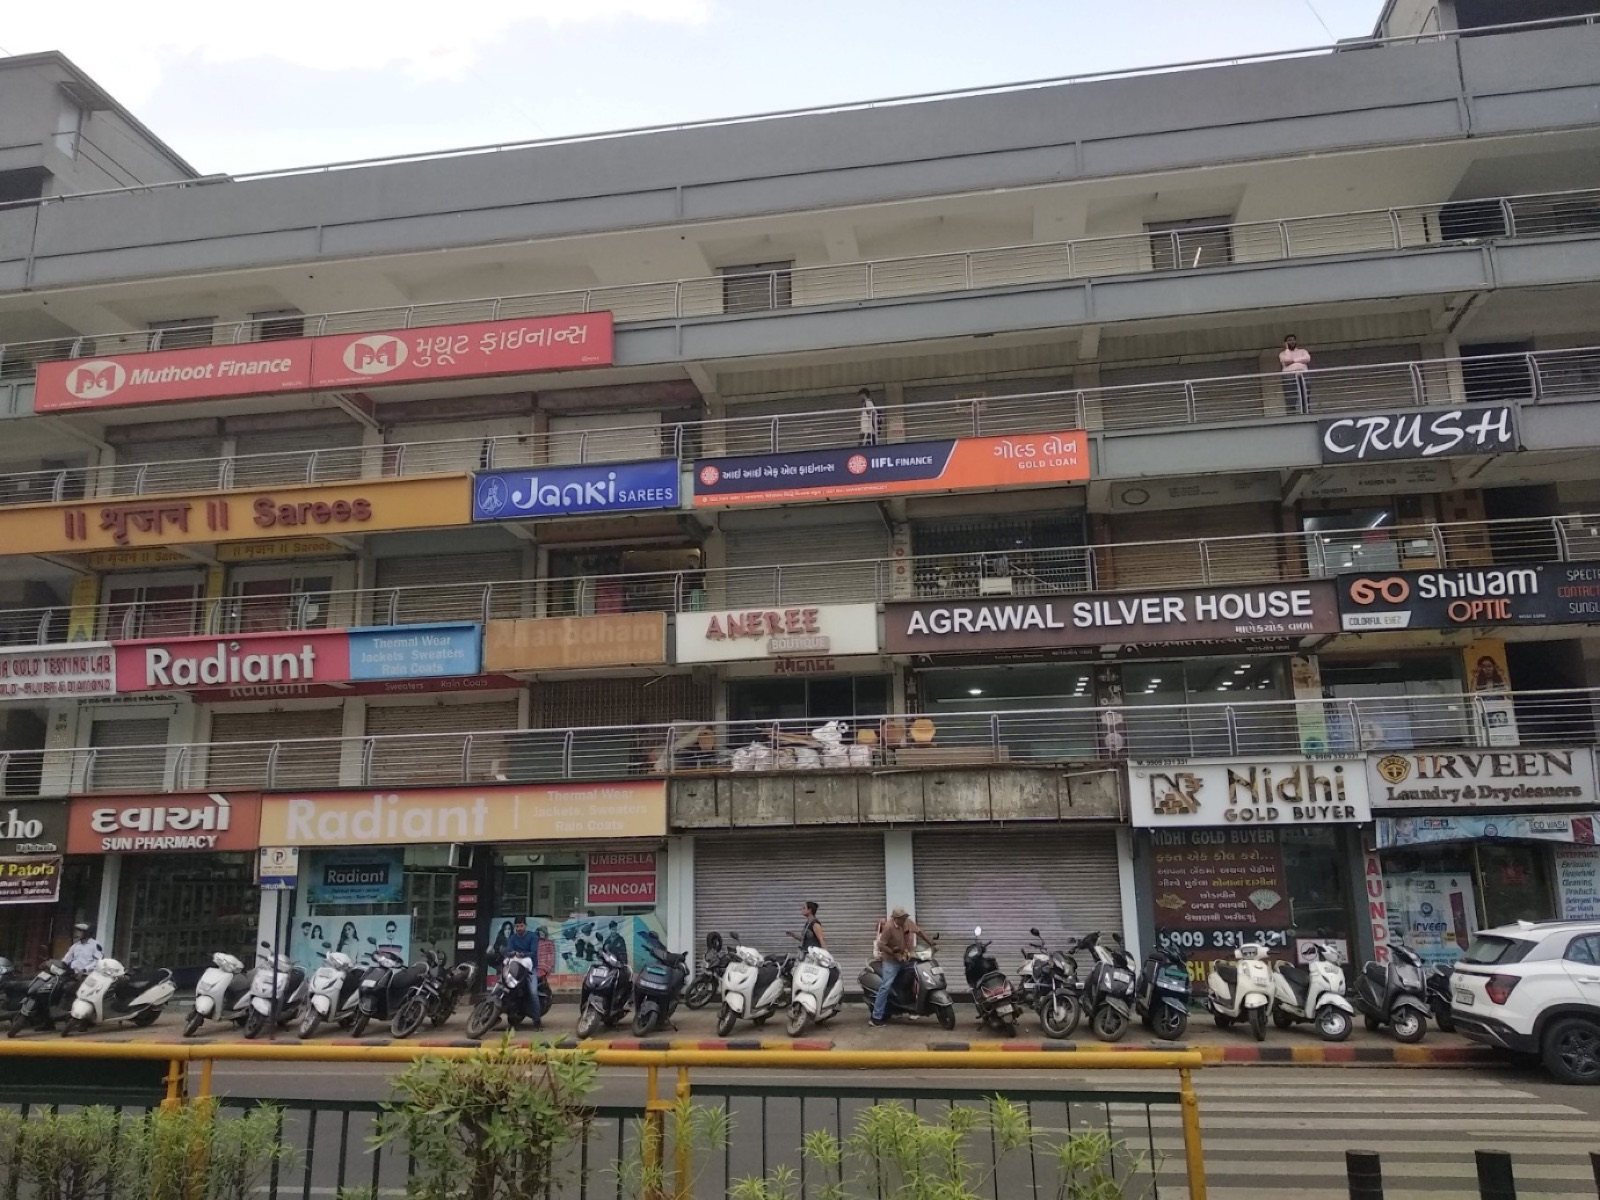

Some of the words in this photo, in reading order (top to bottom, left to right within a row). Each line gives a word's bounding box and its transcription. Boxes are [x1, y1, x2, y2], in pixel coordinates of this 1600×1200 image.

[413, 335, 469, 367] મુથૂટ
[129, 363, 213, 385] Muthoot
[216, 357, 292, 378] Finance
[1323, 408, 1511, 458] CRUSH
[994, 440, 1036, 459] ગોલ્ડ
[1043, 436, 1078, 456] લોન
[871, 457, 894, 469] IIFL
[895, 455, 933, 467] FINANCE
[1018, 460, 1046, 469] GOLD
[1049, 457, 1077, 467] LOAN
[511, 471, 617, 509] Janki
[619, 487, 674, 503] SAREES
[253, 497, 372, 527] Sarees
[294, 539, 332, 553] Sarees
[1417, 568, 1539, 599] Shivam
[907, 603, 1065, 635] AGRAWAL
[1073, 596, 1187, 628] SILVER
[1194, 589, 1314, 621] HOUSE
[1447, 598, 1512, 622] OPTIC
[705, 608, 821, 640] ANEREE
[1348, 616, 1382, 626] COLORFUL
[373, 636, 418, 649] Thermal
[421, 635, 452, 647] Wear
[771, 638, 825, 650] BOUTIQUE
[91, 654, 112, 673] LAB
[145, 642, 316, 687] Radiant
[360, 652, 405, 664] Jackets
[411, 648, 465, 661] Sweaters
[382, 664, 408, 675] Rain
[411, 662, 444, 674] Coats
[384, 682, 425, 691] Sweaters
[441, 679, 461, 688] Rain
[463, 678, 488, 688] Coats
[1413, 751, 1574, 780] IRVEEN
[1227, 764, 1347, 804] Nidhi
[546, 789, 598, 802] Thermal
[602, 787, 635, 800] Wear
[1386, 786, 1462, 803] Laundry
[1461, 784, 1477, 799] &
[1476, 783, 1583, 803] Drycleaners
[91, 794, 232, 834] દવાઓ
[590, 803, 648, 815] Sweaters
[1224, 807, 1279, 822] GOLD
[1292, 805, 1357, 821] BUYER
[285, 794, 489, 842] Radiant
[555, 821, 583, 833] Rain
[588, 819, 625, 831] Coats
[101, 837, 134, 851] SUN
[135, 834, 218, 850] PHARMACY
[1151, 830, 1187, 846] NIDHI
[1191, 831, 1225, 845] GOLD
[1231, 828, 1276, 844] BUYER
[590, 853, 654, 865] UMBRELLA
[8, 863, 56, 878] Patola
[326, 868, 386, 883] Radiant
[588, 881, 655, 895] RAINCOAT
